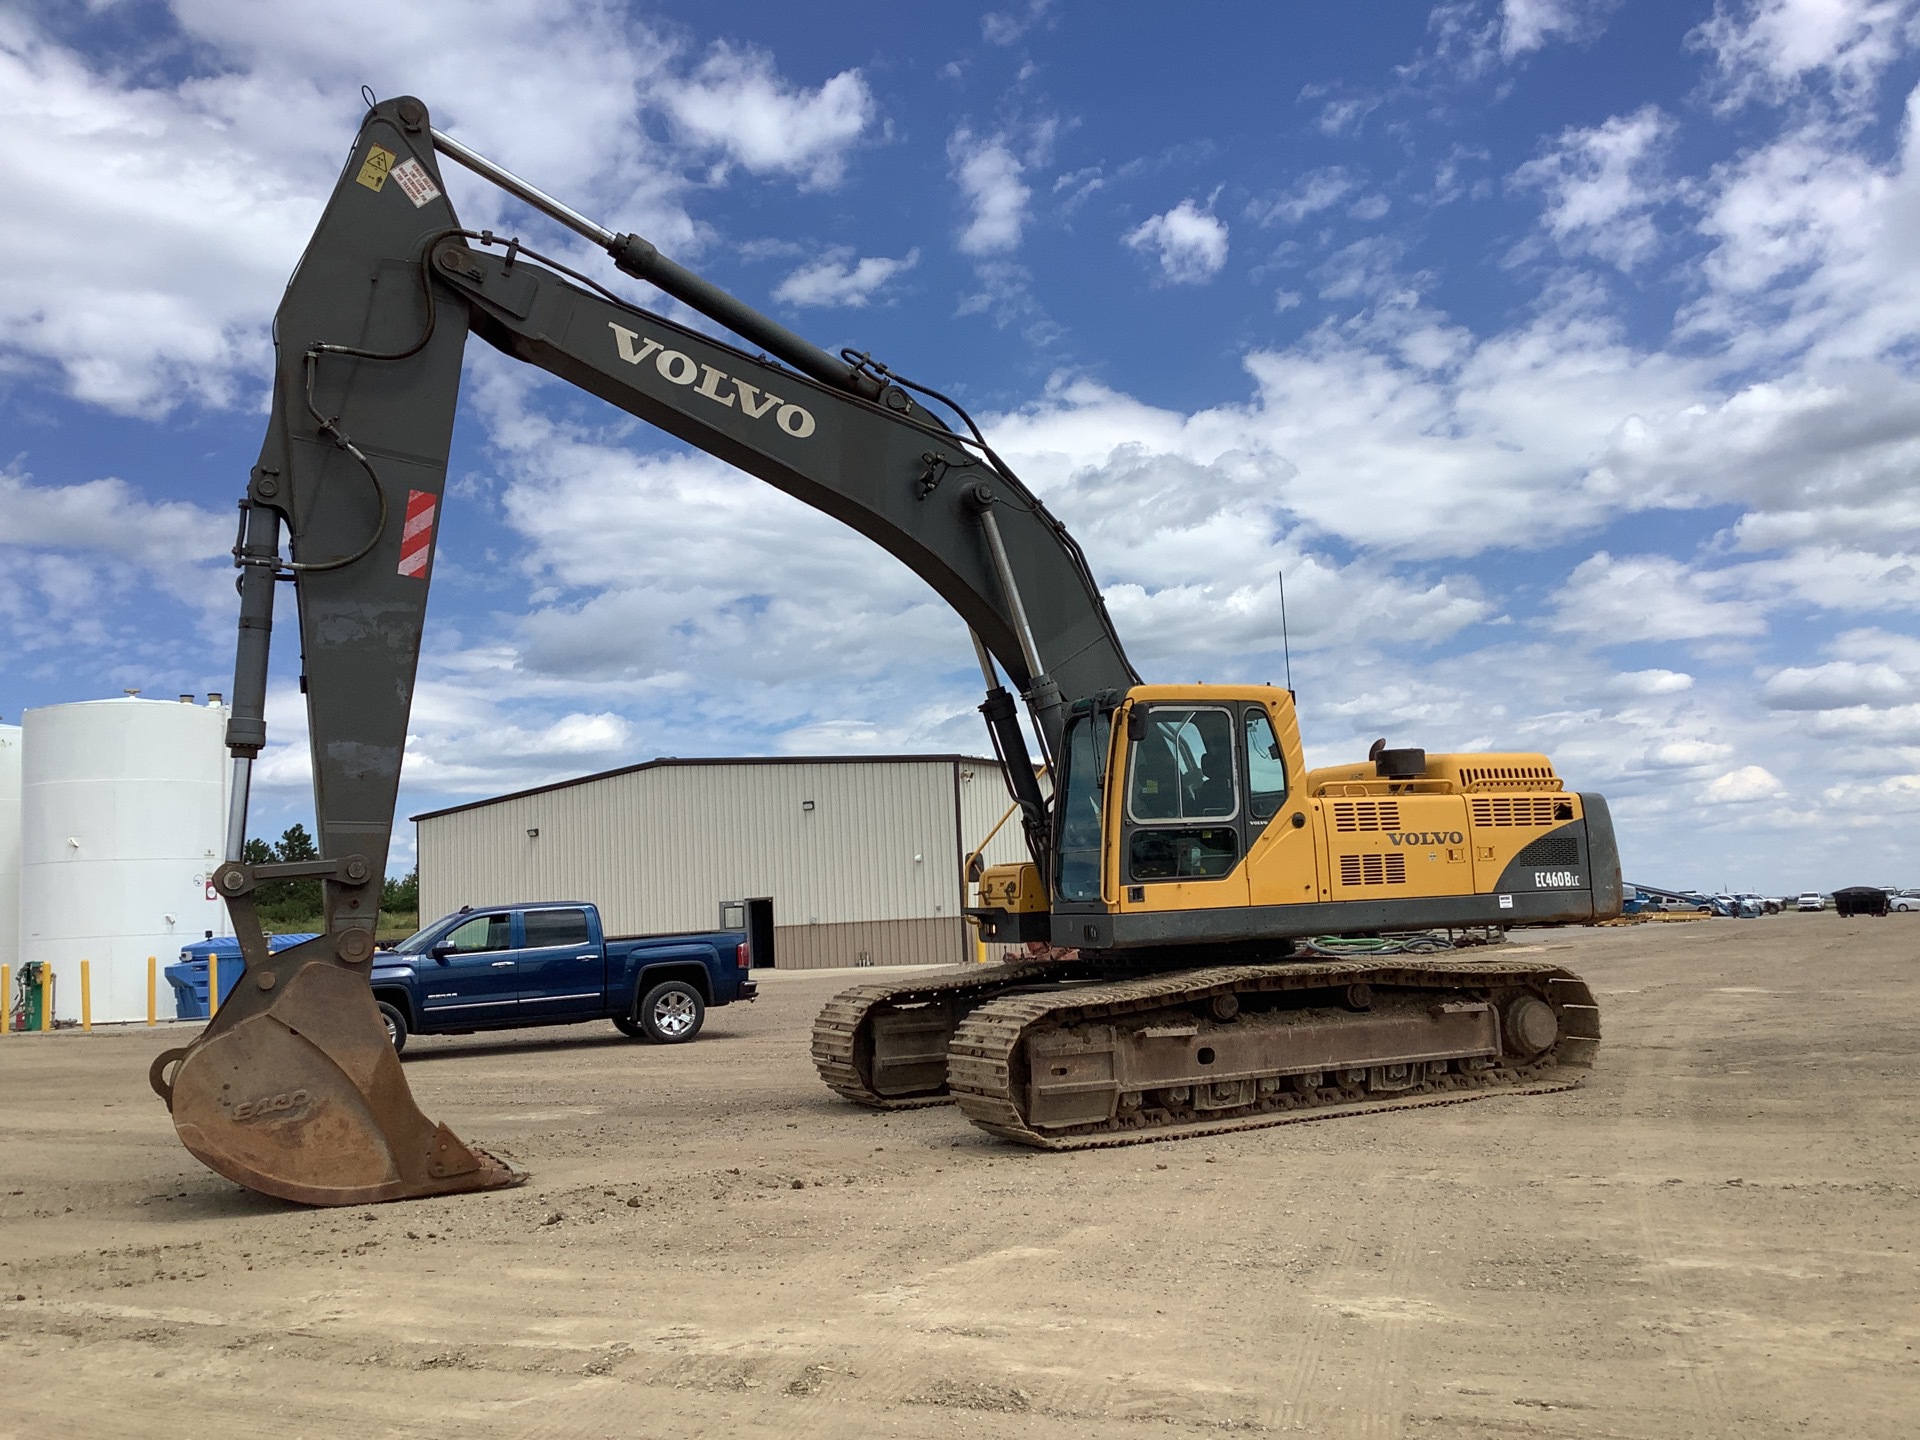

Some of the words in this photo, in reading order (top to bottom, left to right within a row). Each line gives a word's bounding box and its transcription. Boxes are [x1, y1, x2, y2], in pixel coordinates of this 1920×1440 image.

[412, 164, 424, 178] REMOVE
[422, 178, 435, 192] GREASE
[608, 321, 816, 438] VOLVO
[1386, 831, 1464, 846] VOLVO
